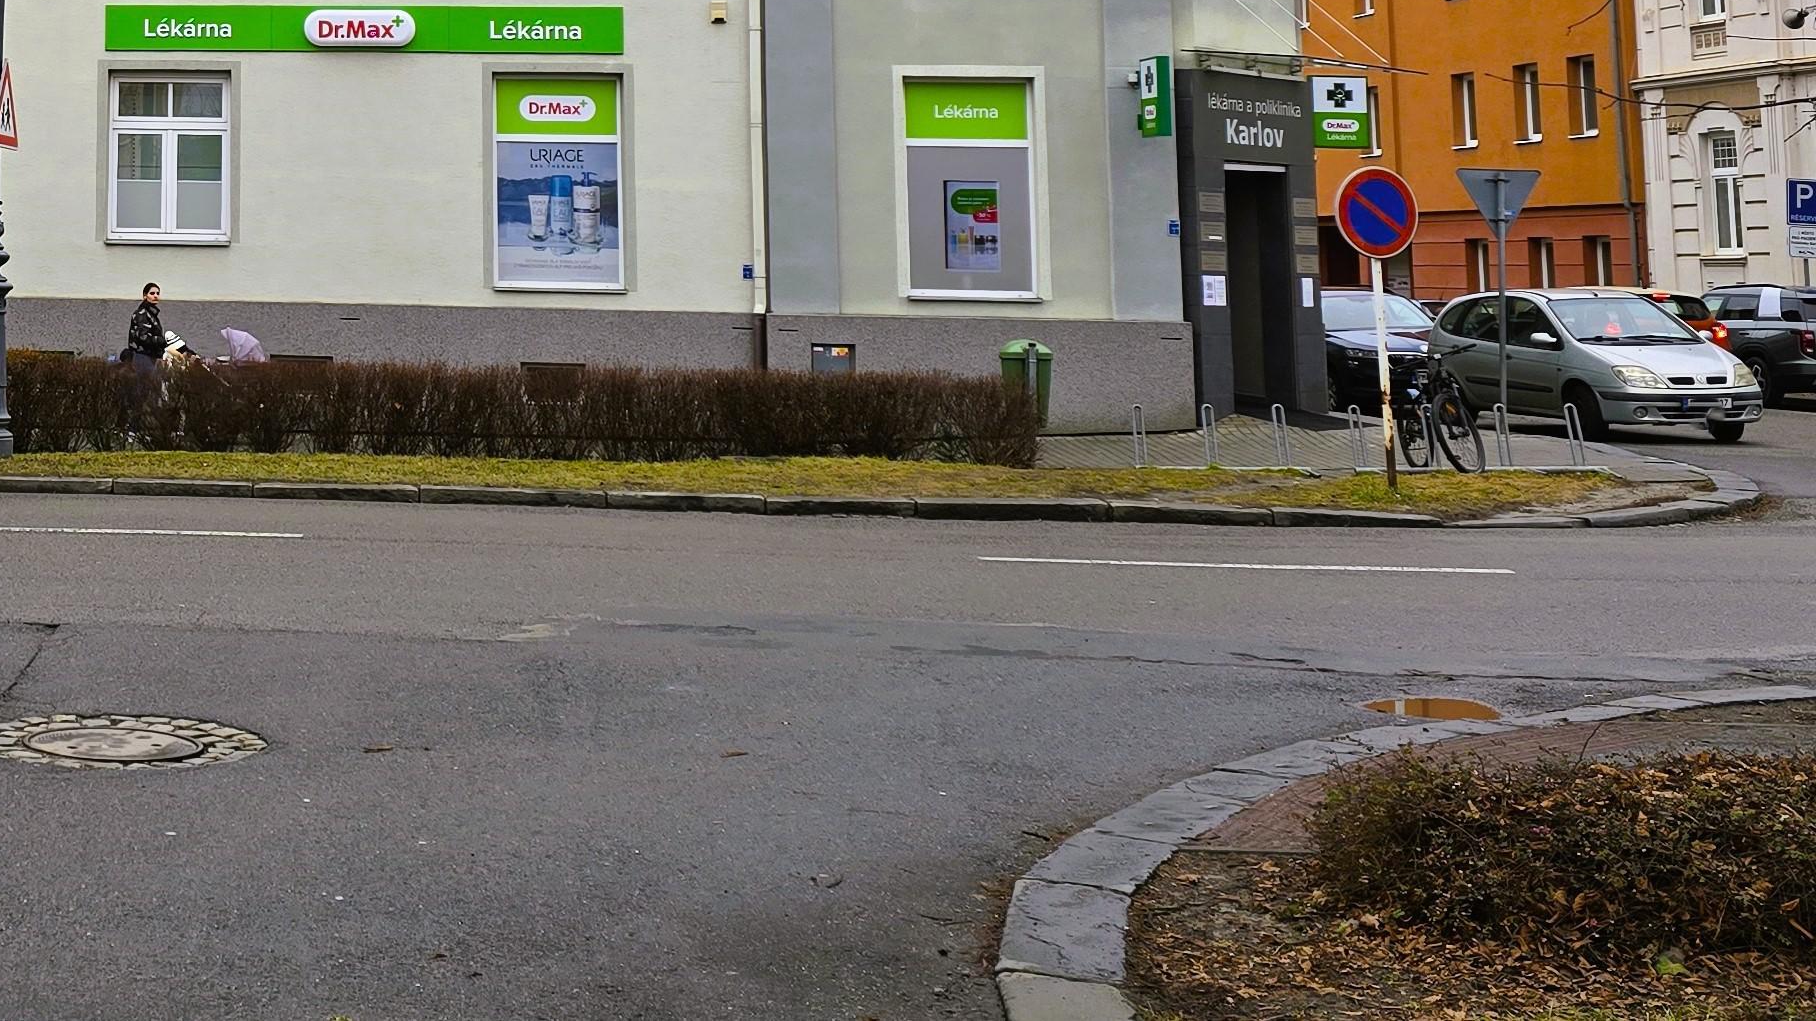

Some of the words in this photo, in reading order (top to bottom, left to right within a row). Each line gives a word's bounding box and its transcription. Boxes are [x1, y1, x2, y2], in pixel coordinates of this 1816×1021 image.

[143, 17, 233, 40] Lékárna
[488, 18, 583, 41] Lékárna
[933, 103, 1000, 119] Lékárna
[1207, 91, 1244, 112] lékárna
[1246, 100, 1253, 113] a
[1255, 98, 1302, 117] poliklinika
[1225, 118, 1284, 148] Karlov
[529, 148, 585, 164] URIAGE
[1796, 183, 1814, 209] P
